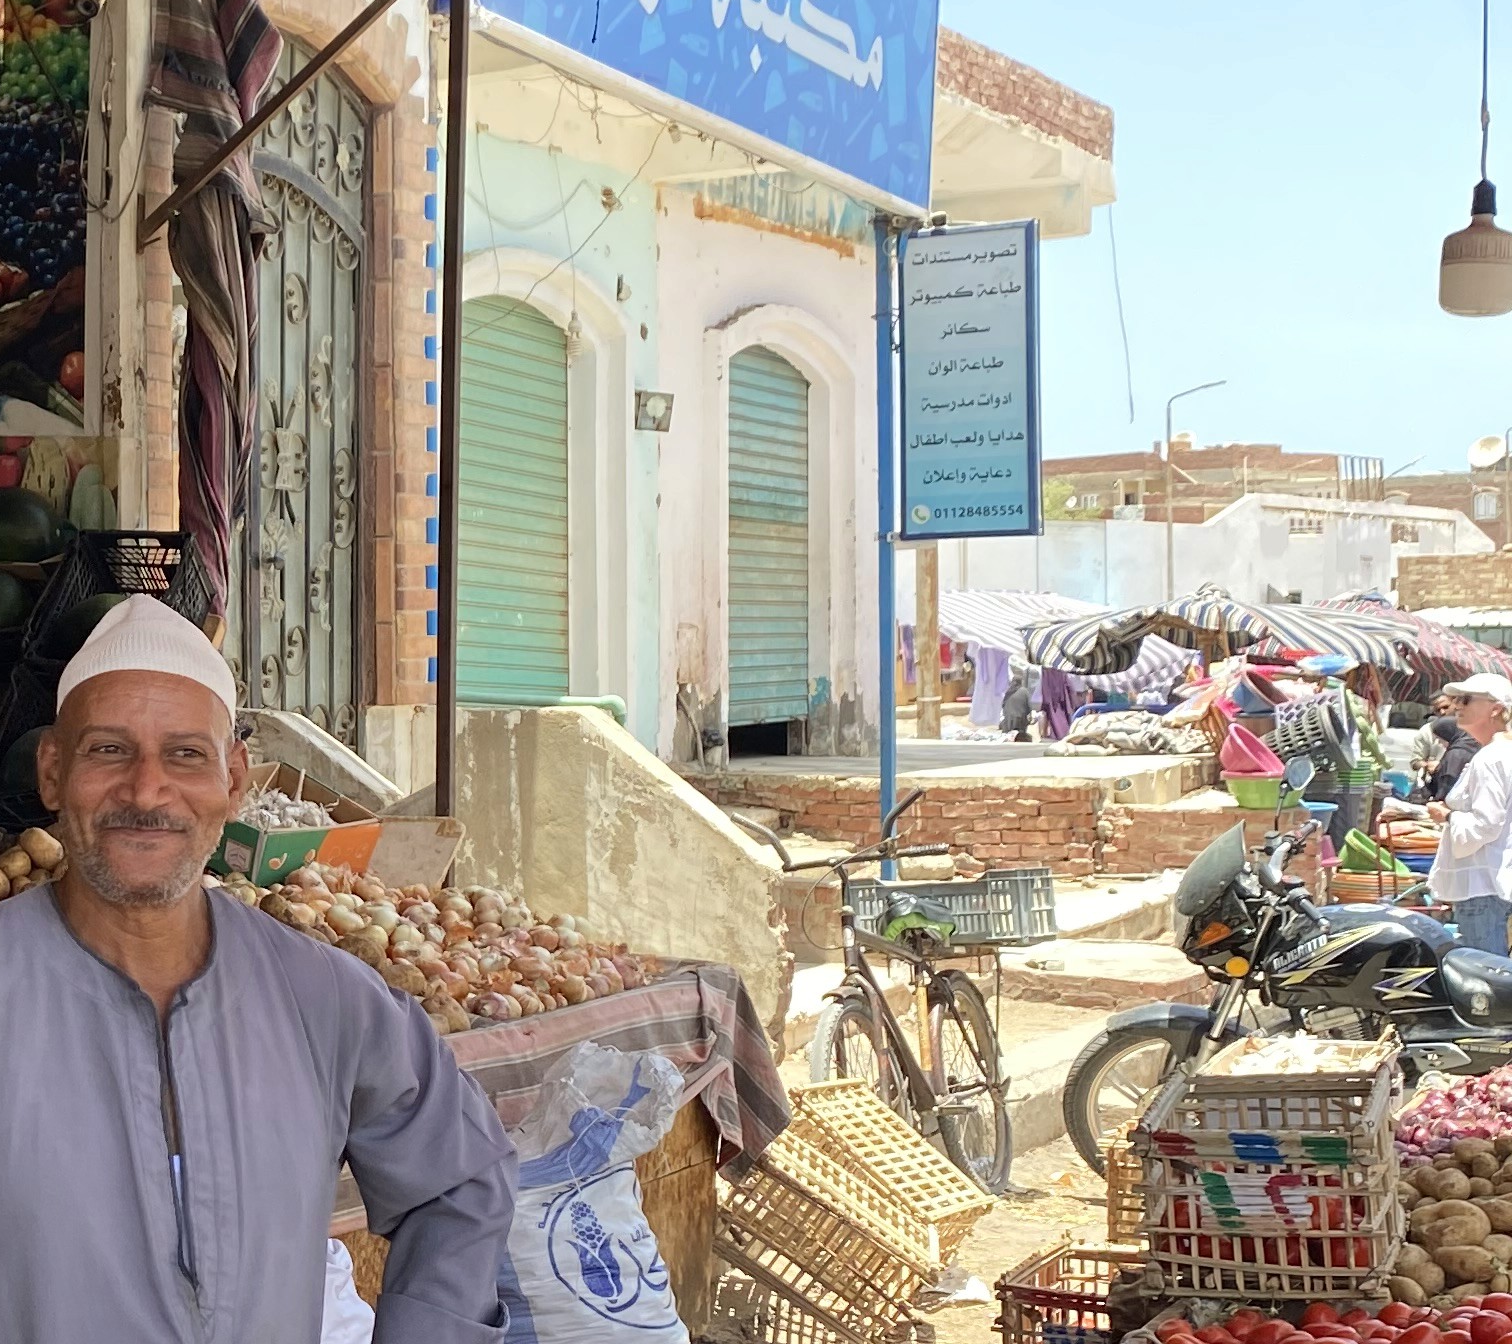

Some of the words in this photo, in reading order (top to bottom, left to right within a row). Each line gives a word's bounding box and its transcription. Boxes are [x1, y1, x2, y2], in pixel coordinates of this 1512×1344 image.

[909, 286, 973, 305] كمبيوتر
[977, 282, 1022, 298] طباعة
[928, 359, 957, 376] الوان
[960, 356, 1004, 373] طباعة
[921, 397, 975, 413] مدرسية
[977, 392, 1012, 408] ادوات
[909, 432, 947, 449] اطفال
[950, 431, 984, 448] ولعب
[988, 429, 1025, 445] هدايا
[969, 466, 1012, 483] دعاية
[934, 504, 1024, 519] 01128485554
